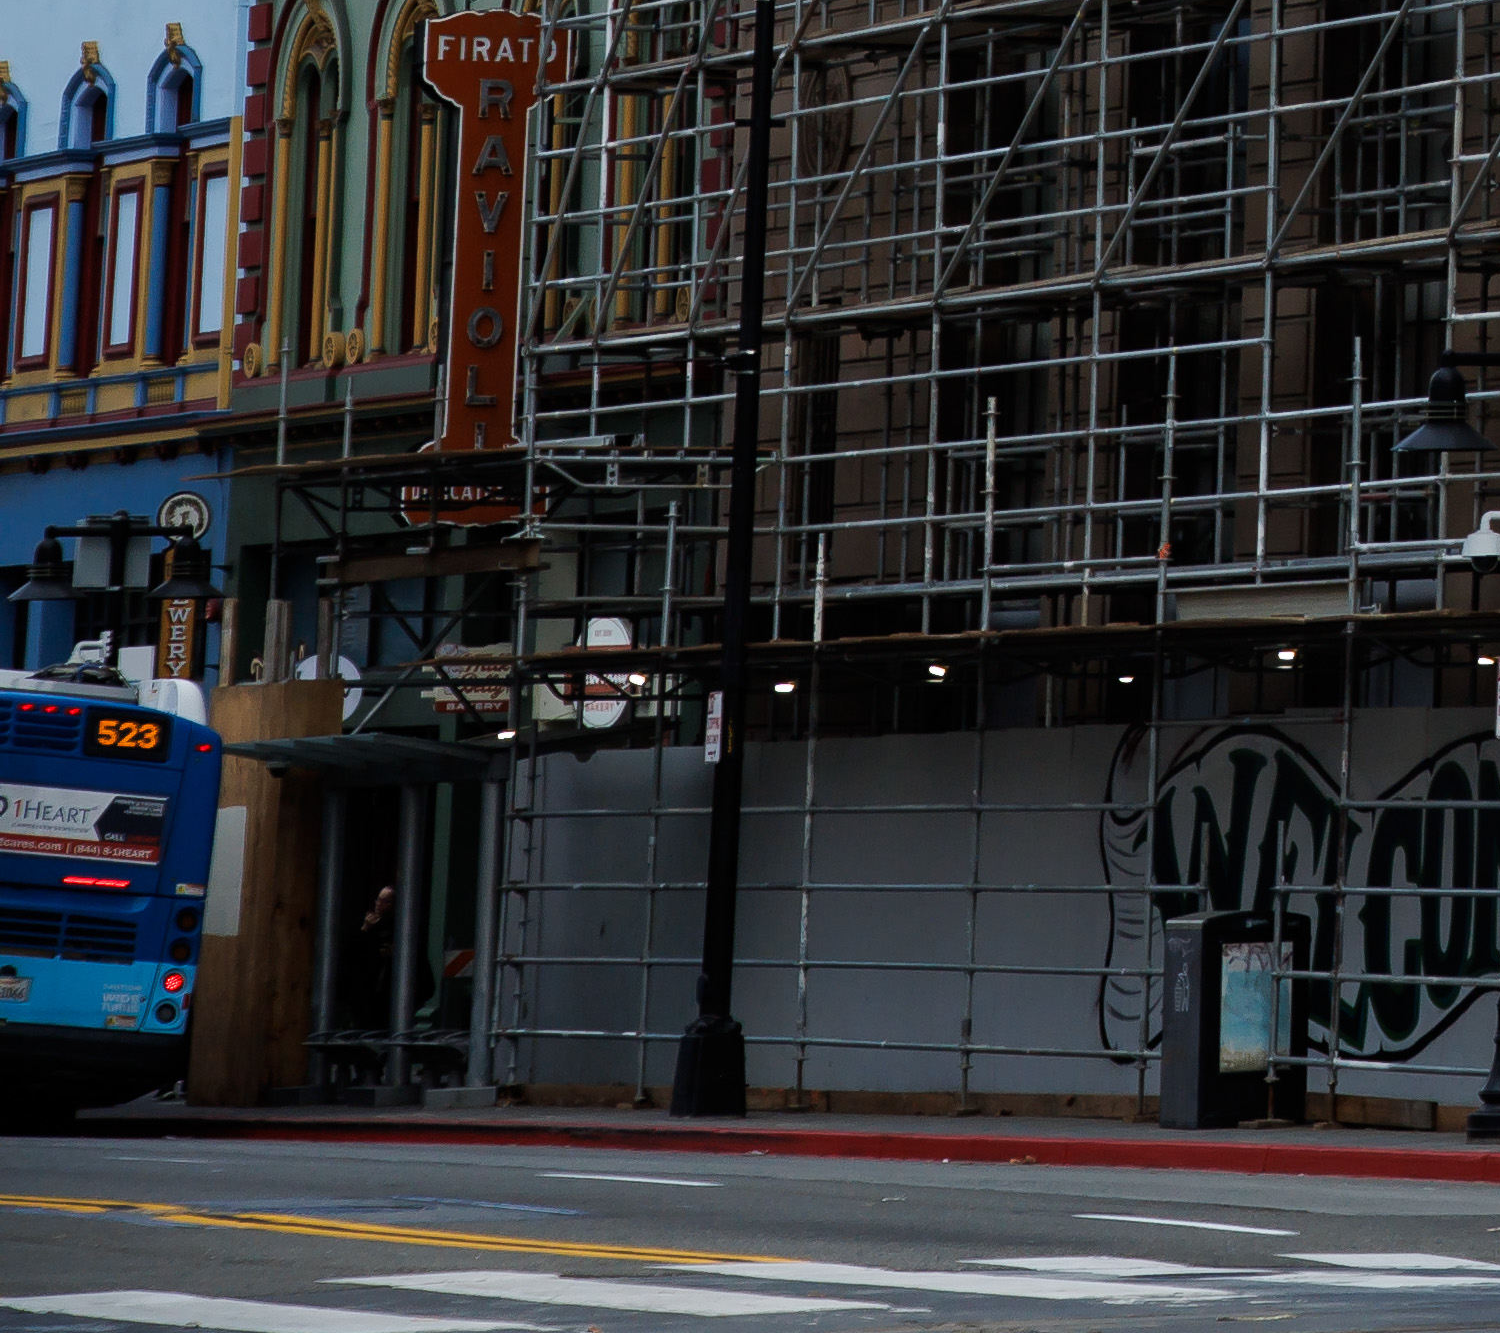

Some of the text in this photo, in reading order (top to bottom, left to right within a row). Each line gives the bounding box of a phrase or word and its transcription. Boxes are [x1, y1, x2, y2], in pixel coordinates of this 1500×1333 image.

[446, 702, 503, 711] BAERY
[98, 720, 159, 749] 523
[104, 833, 125, 842] CALL
